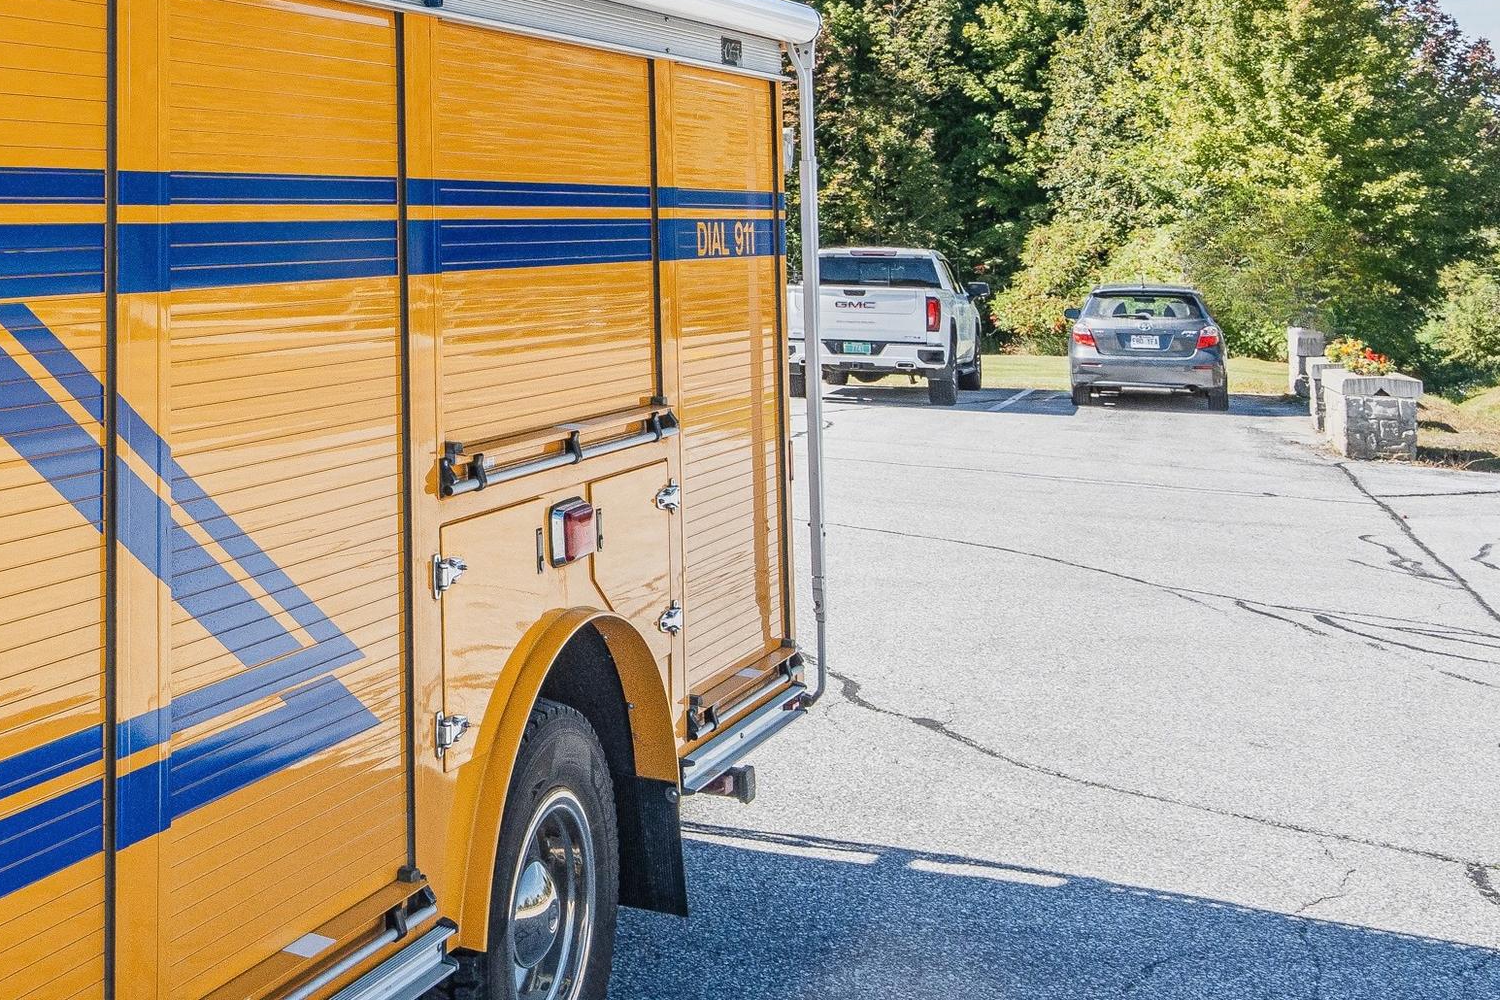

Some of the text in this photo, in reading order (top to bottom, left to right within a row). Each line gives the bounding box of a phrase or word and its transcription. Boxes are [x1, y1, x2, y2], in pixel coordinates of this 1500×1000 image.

[697, 221, 755, 256] DIAL 911
[834, 301, 876, 309] GMC
